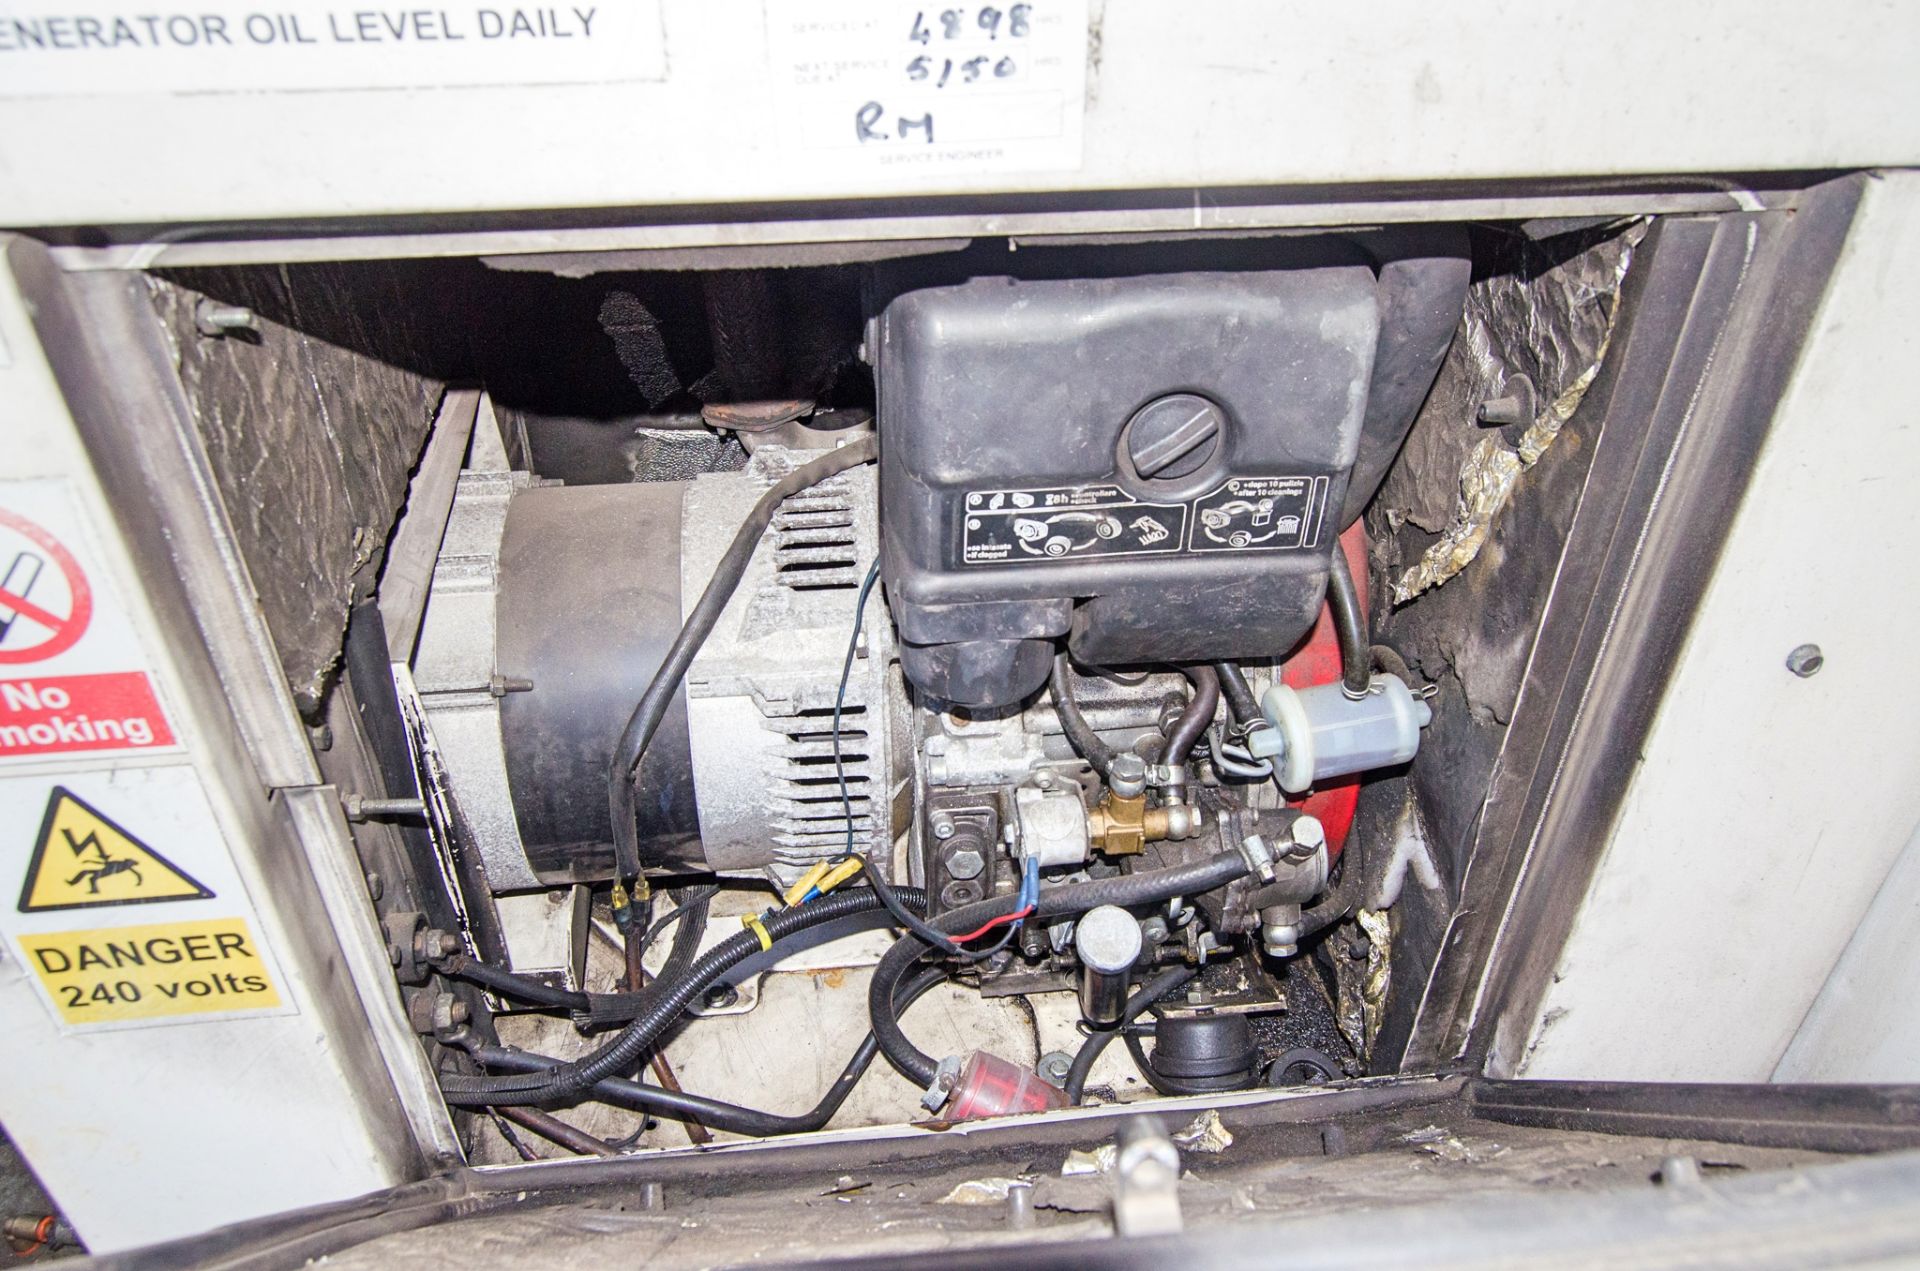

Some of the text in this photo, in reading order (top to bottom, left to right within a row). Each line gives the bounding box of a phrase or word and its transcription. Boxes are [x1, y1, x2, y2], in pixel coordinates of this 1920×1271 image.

[244, 12, 317, 45] OIL
[330, 9, 465, 43] LEVEL
[478, 7, 597, 40] DAILY
[879, 148, 1005, 166] SERVICE ENGINEER
[1238, 489, 1257, 497] after
[0, 681, 71, 713] No
[34, 931, 254, 974] DANGER
[59, 972, 269, 1009] 240 volts
